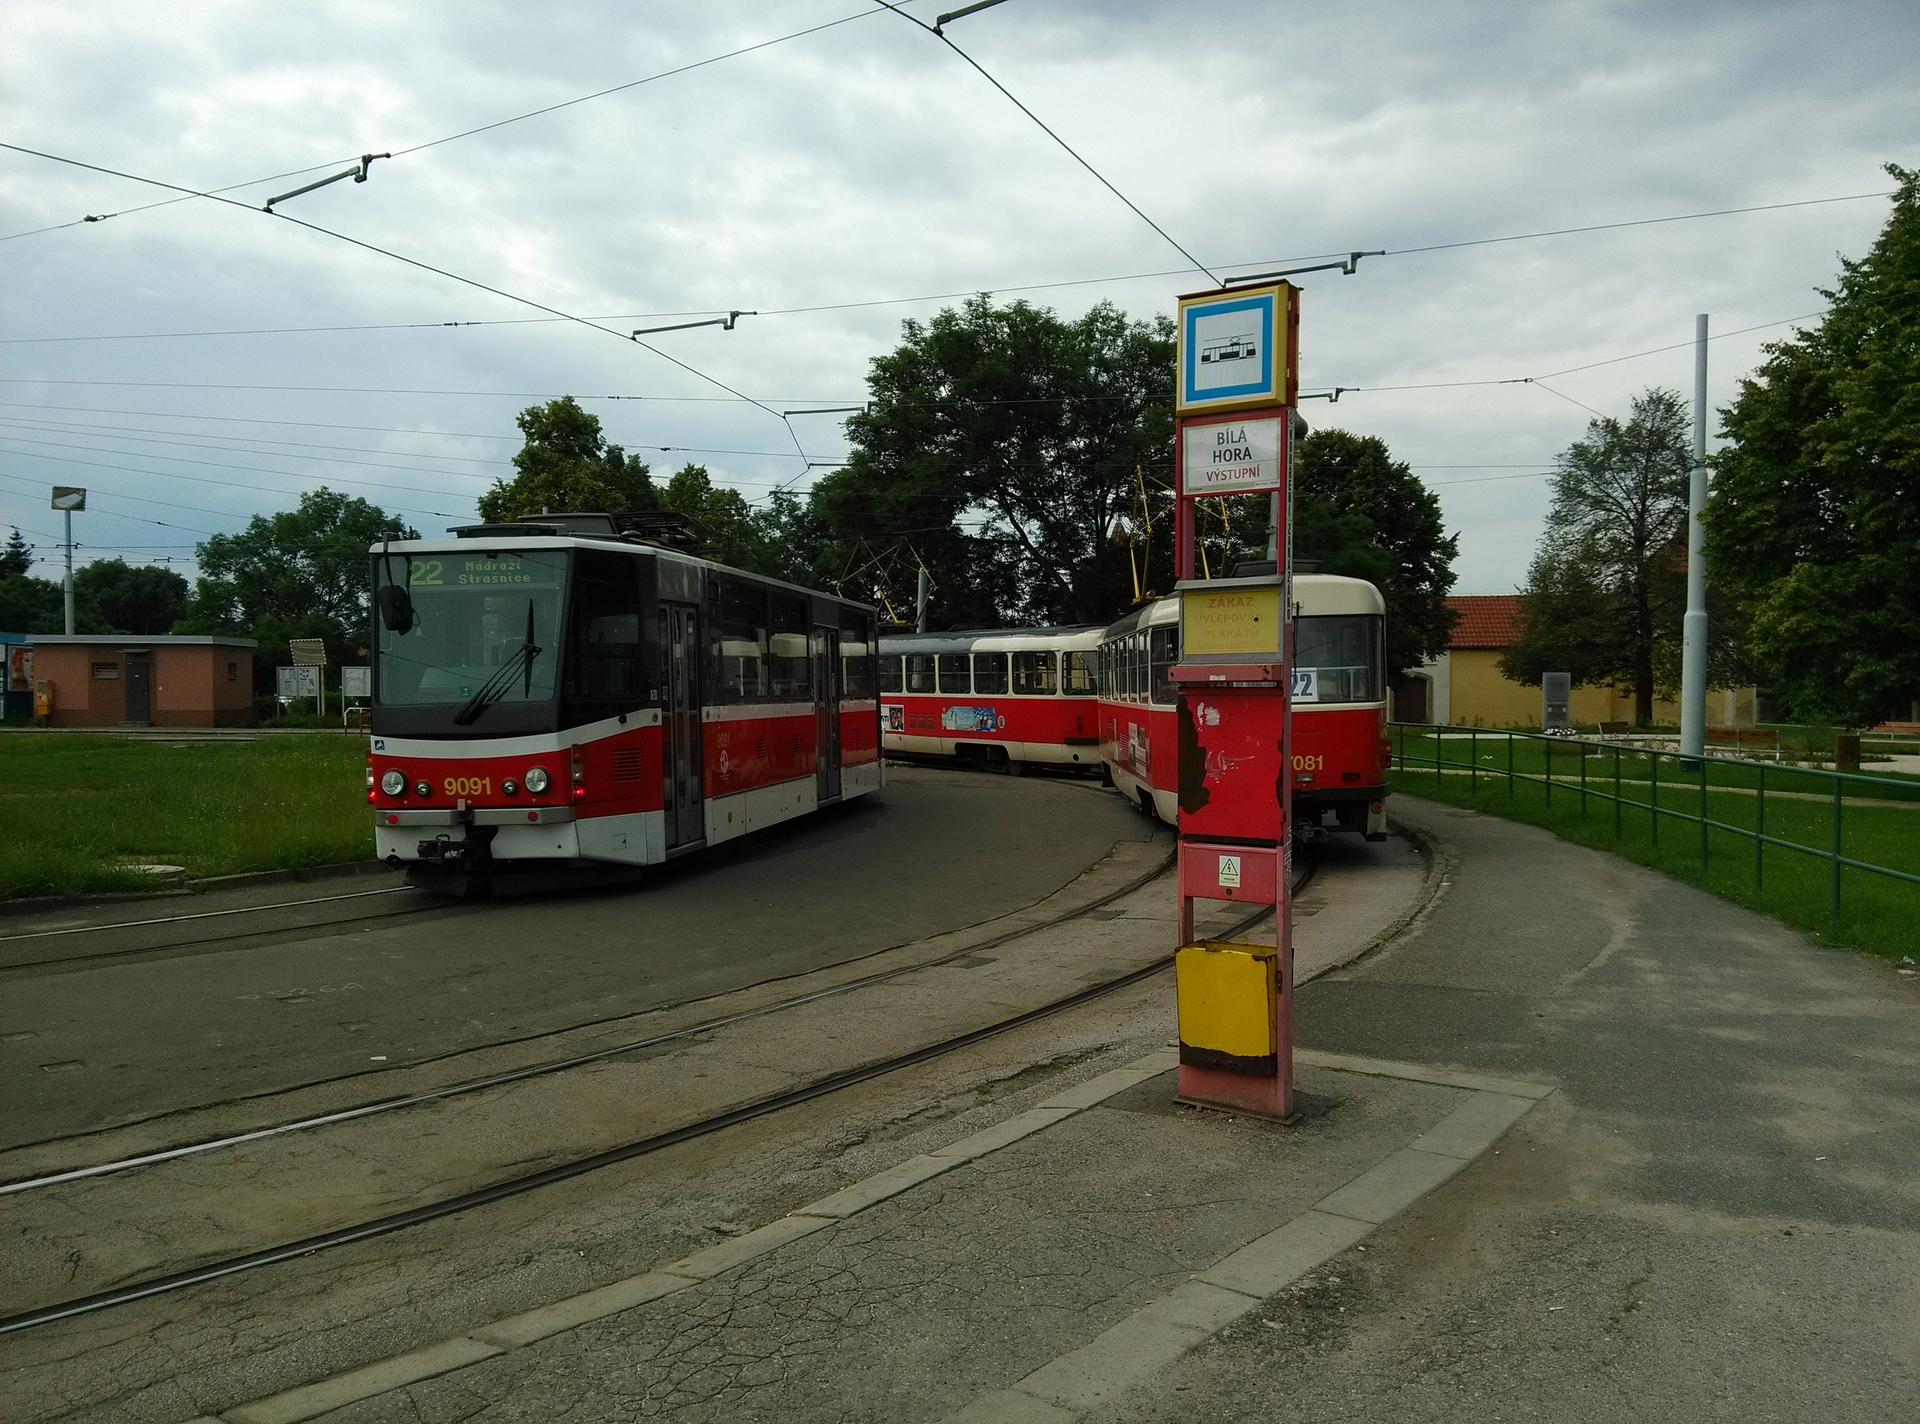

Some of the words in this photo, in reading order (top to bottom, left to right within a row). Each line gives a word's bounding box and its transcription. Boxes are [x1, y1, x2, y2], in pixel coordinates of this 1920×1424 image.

[1217, 426, 1247, 445] BÍLÁ
[1213, 446, 1252, 464] HORA
[1206, 464, 1260, 482] VÝSTUPNÍ
[410, 560, 443, 586] 22
[465, 558, 522, 571] Nádraží
[458, 572, 531, 584] Strašnice
[1208, 595, 1254, 609] ZÁKAZ
[1195, 609, 1268, 624] VYLEPOVÁNÍ
[1291, 673, 1313, 696] 22
[1291, 755, 1323, 771] 081
[444, 776, 491, 796] 9091
